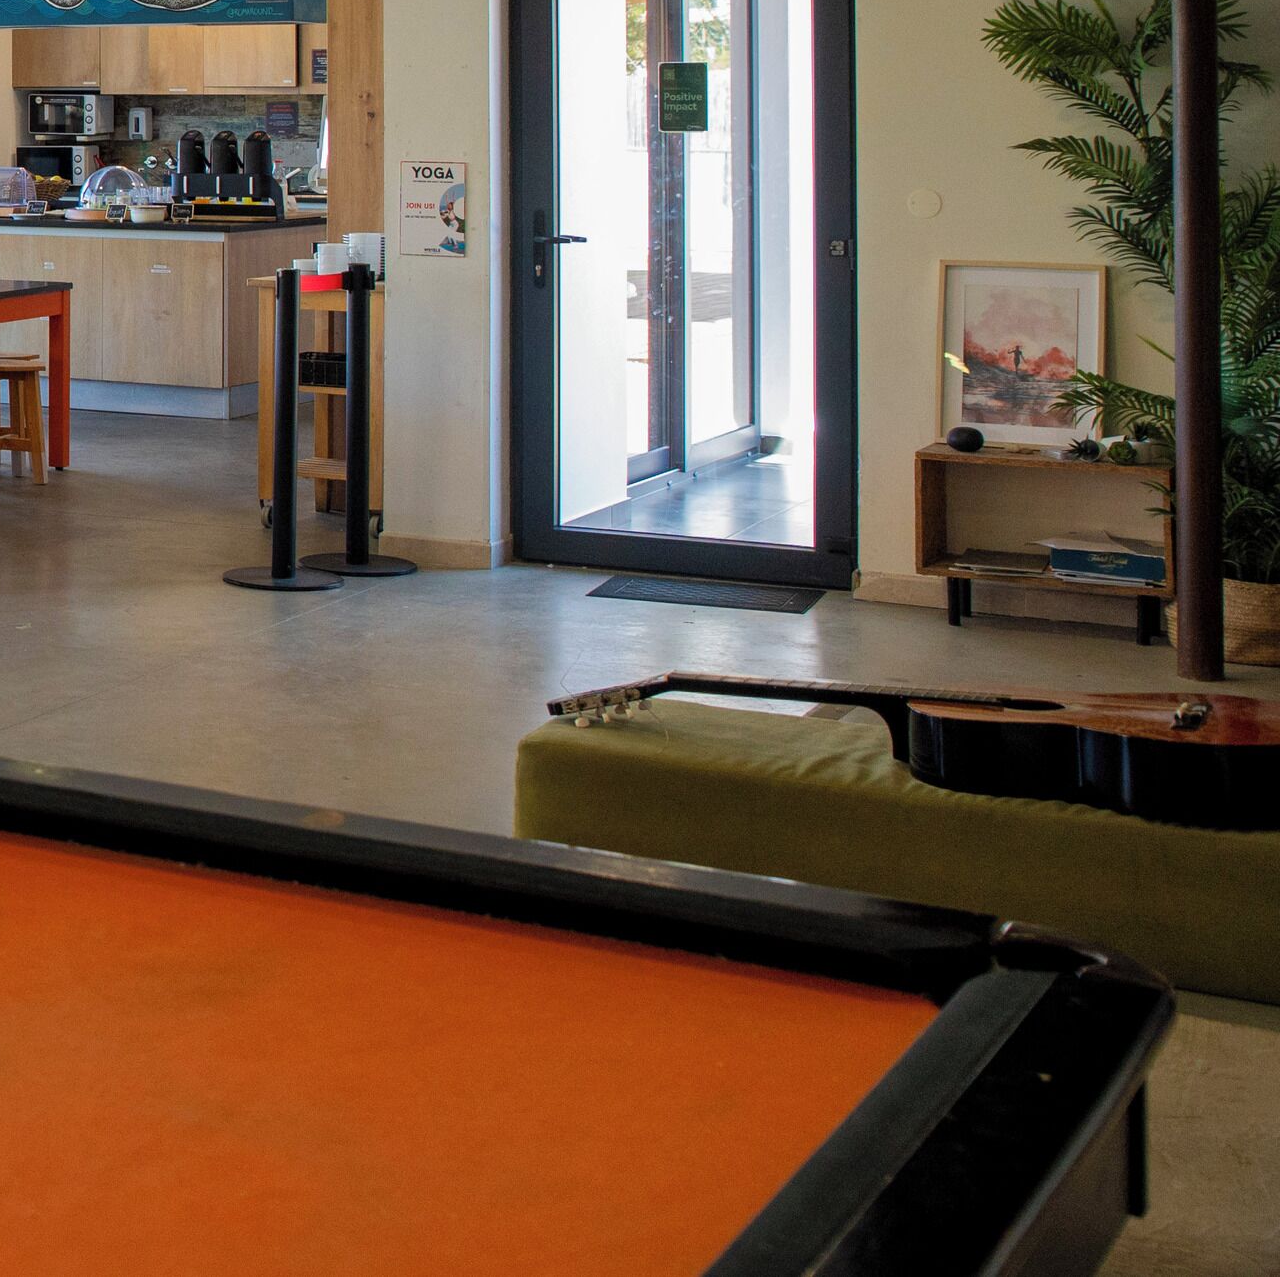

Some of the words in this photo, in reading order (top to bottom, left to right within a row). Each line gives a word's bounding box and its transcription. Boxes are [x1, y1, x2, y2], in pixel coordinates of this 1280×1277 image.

[664, 92, 703, 101] Positive
[664, 102, 698, 112] Impact
[412, 166, 454, 179] YOGA
